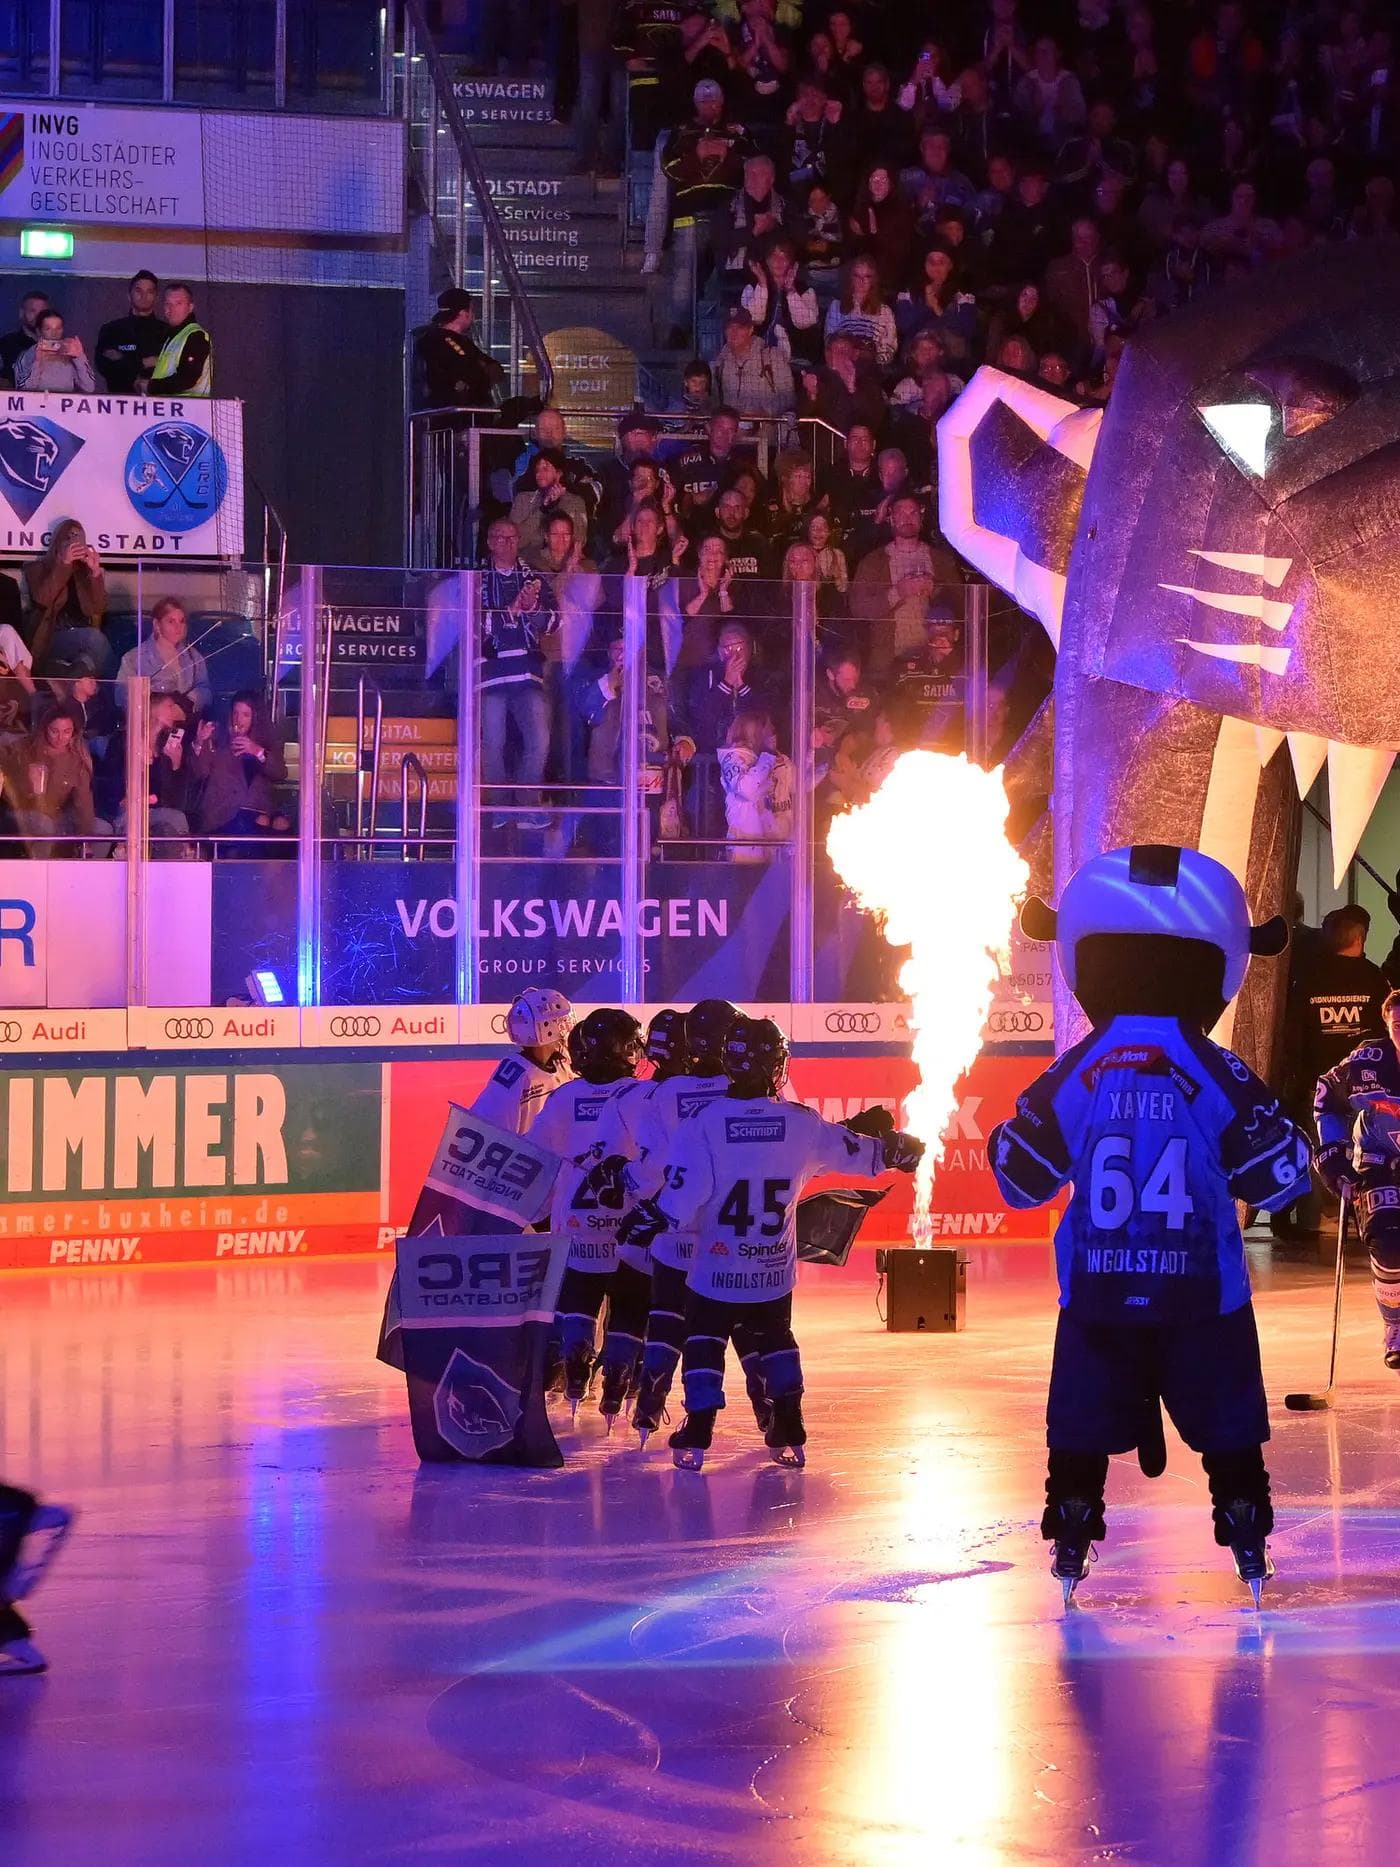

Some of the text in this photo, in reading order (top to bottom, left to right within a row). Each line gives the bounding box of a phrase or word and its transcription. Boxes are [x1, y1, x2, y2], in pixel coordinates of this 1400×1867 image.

[453, 83, 546, 99] KSWAGEN
[32, 113, 79, 136] INVG
[481, 109, 552, 121] SERVICES
[32, 139, 176, 166] INGOLSTÄDTER
[30, 166, 144, 190] VERKEHRS-
[30, 191, 179, 216] GESELLSCHAFT
[61, 397, 185, 417] PANTHER
[7, 530, 184, 551] INGSTADT
[337, 643, 417, 657] SERVICES
[396, 899, 728, 937] VOLKSWAGEN
[478, 958, 651, 974] GROUP SERVICS
[32, 1021, 86, 1041] Audi
[223, 1019, 276, 1037] Audi
[391, 1017, 445, 1035] Audi
[1109, 1090, 1174, 1121] XAVER
[7, 1073, 289, 1192] IMMER
[728, 1121, 782, 1138] SCHMIDT
[1090, 1136, 1194, 1230] 64
[718, 1178, 791, 1237] 45
[1370, 1189, 1399, 1208] DB
[1087, 1249, 1188, 1275] INGOLSTADT
[710, 1269, 786, 1289] INGOLSTADT
